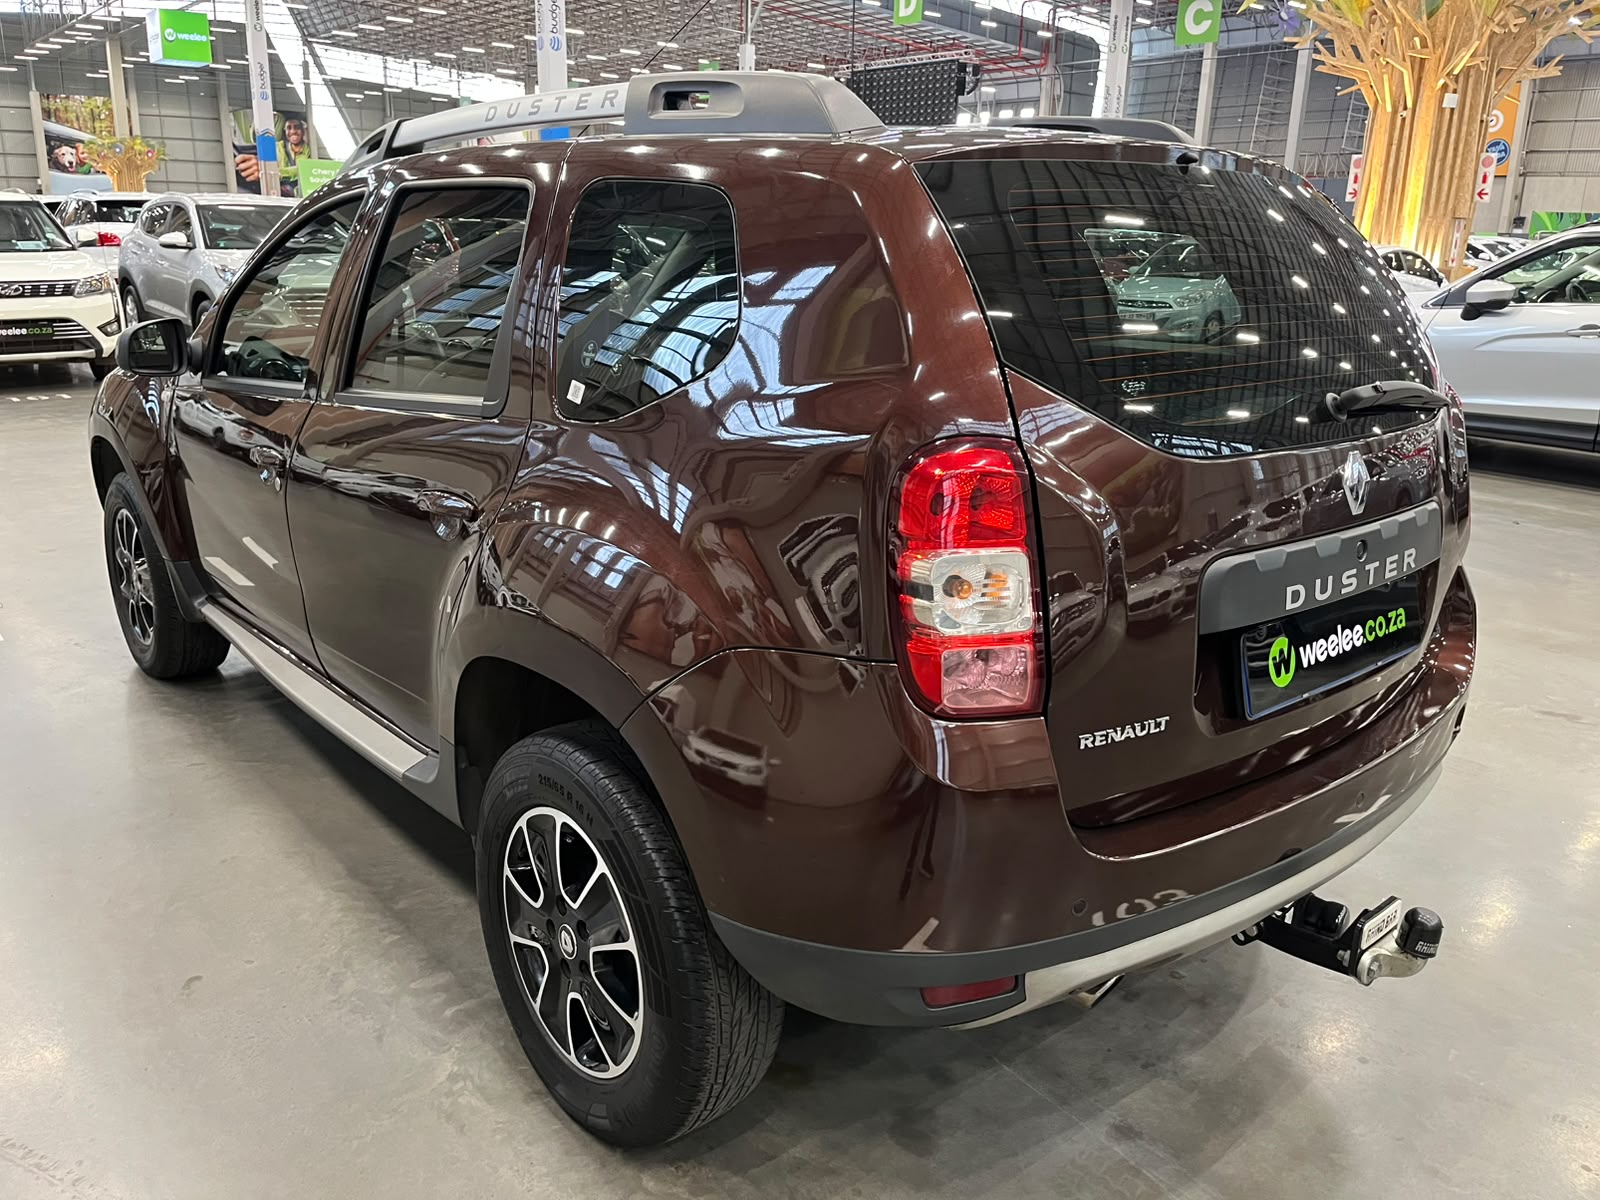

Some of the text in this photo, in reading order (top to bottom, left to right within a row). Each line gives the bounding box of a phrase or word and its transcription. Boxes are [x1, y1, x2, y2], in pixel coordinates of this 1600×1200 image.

[1184, 0, 1214, 35] C
[177, 32, 207, 42] weelee
[484, 89, 619, 122] DUSTER
[0, 327, 53, 336] eelee.co.za
[1285, 547, 1417, 610] DUSTER
[1299, 607, 1407, 669] weelee.co.za
[1079, 716, 1170, 750] RENAULT
[538, 773, 565, 797] 215/65
